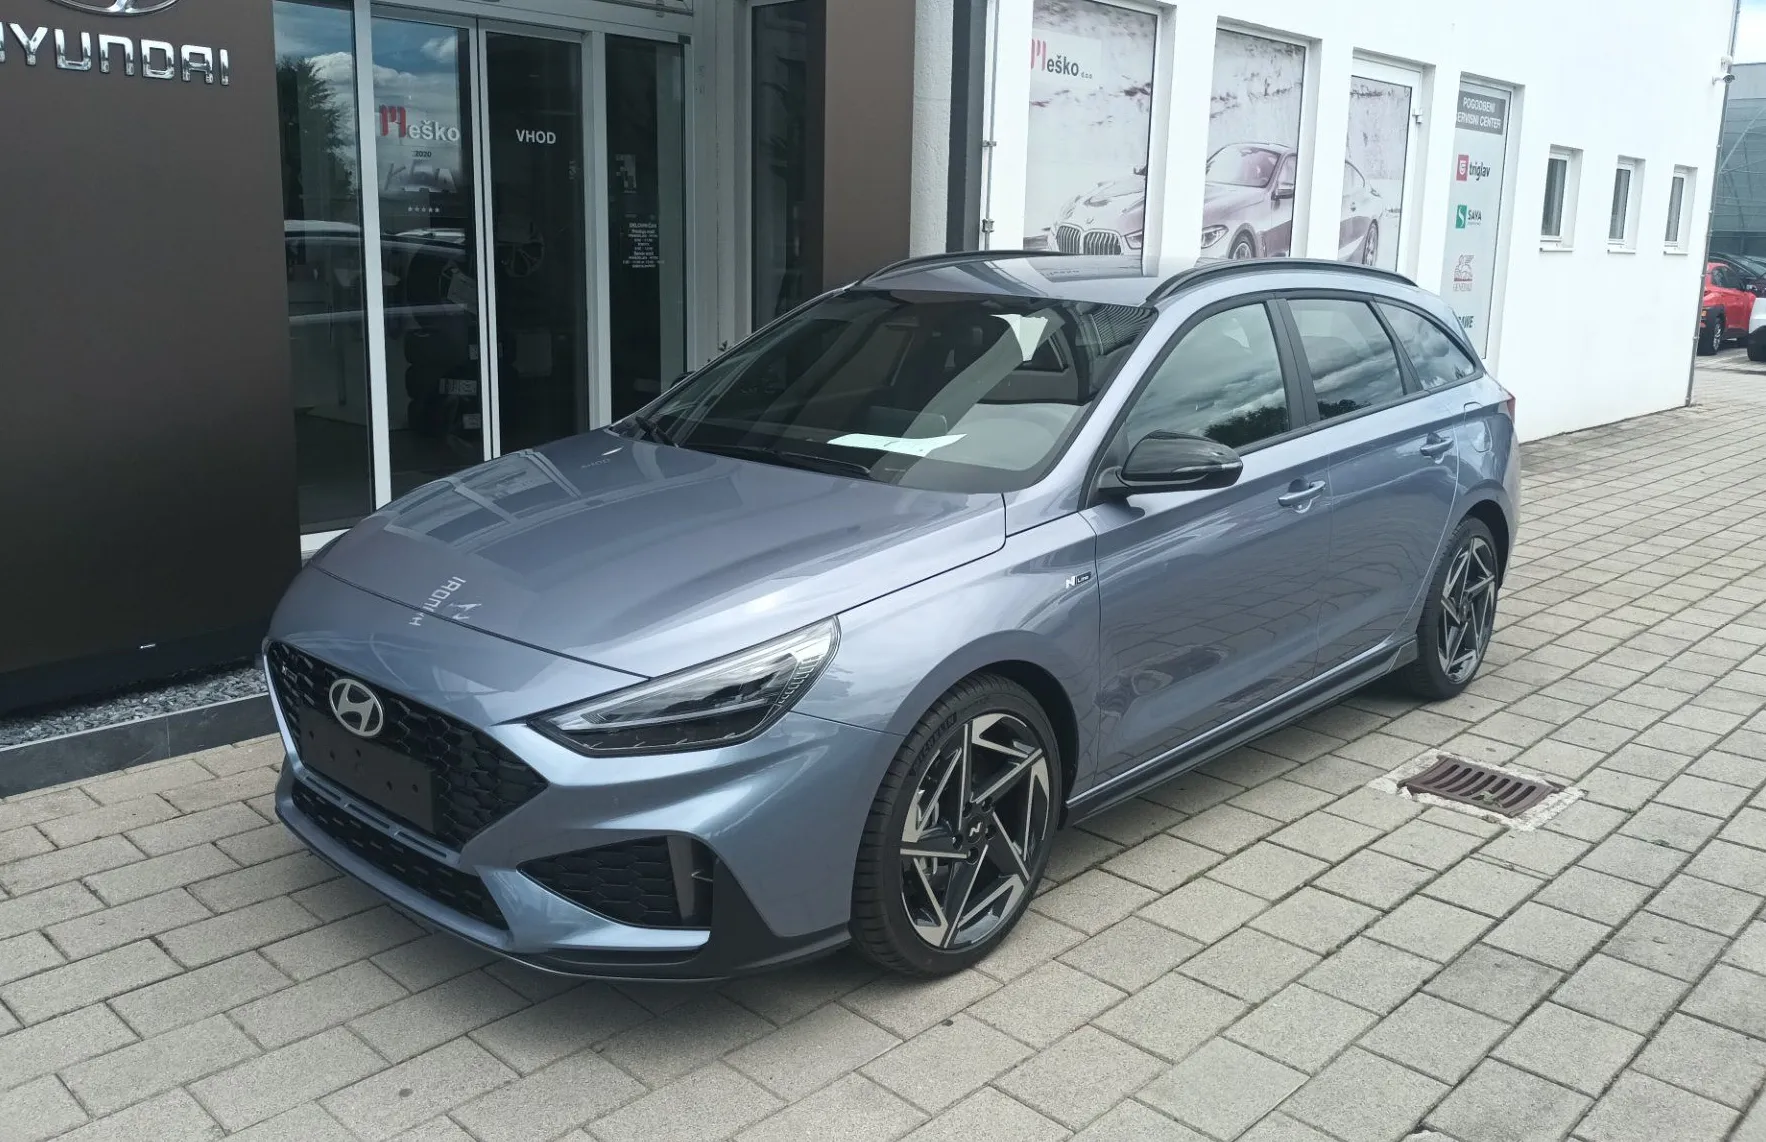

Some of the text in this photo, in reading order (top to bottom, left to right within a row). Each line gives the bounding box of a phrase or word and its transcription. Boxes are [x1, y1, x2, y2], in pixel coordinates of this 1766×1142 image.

[380, 104, 460, 141] Meško
[1457, 112, 1501, 129] ERVISNI CENTER
[515, 129, 557, 144] VHOD
[1469, 162, 1490, 181] triglav
